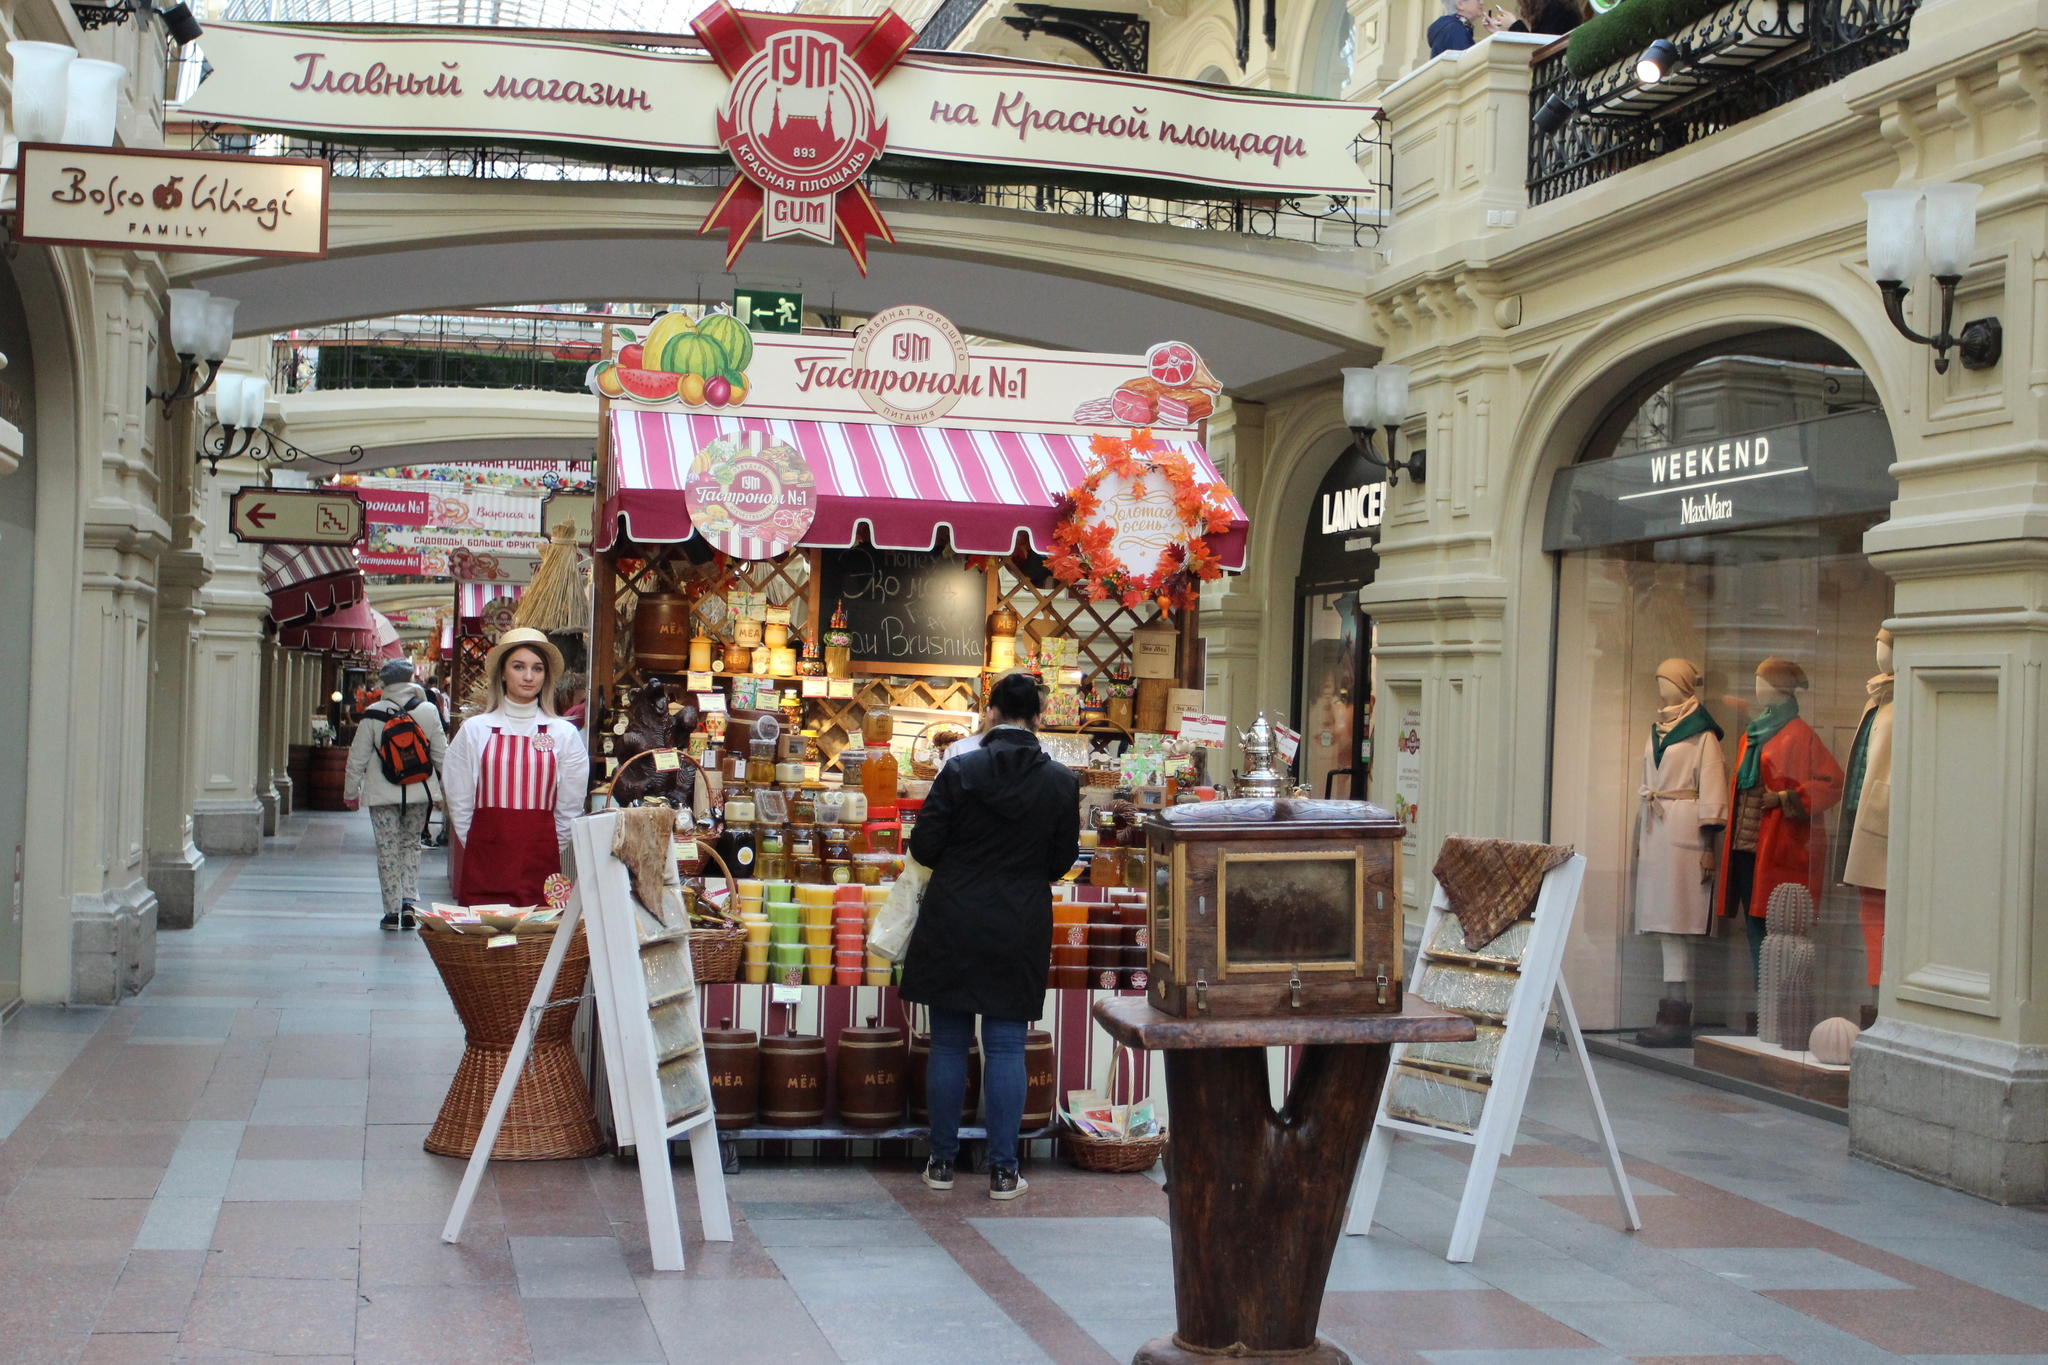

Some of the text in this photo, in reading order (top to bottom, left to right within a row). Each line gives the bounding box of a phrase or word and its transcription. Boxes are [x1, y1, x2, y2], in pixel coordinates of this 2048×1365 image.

[772, 35, 838, 88] ГУМ
[290, 53, 652, 111] Главный магазин
[929, 91, 1307, 168] на Красной площади
[738, 144, 866, 192] КРАСНАЯ ПЛОЩАДЬ
[52, 167, 295, 230] Bosco Ciliegi
[774, 199, 826, 224] GUM
[128, 222, 207, 237] FAMILY
[857, 308, 966, 361] КОМБИНАТ ХОРОШЕГО
[892, 332, 931, 364] ГУМ
[794, 357, 1027, 399] Гастроном №1
[883, 406, 936, 421] ПИТАНИЯ
[1651, 437, 1769, 484] WEEKEND
[695, 486, 807, 506] Гастроном №1
[741, 476, 760, 490] ГУМ
[366, 500, 425, 514] роном №1
[476, 507, 524, 520] Вкусная
[1105, 501, 1177, 530] Золотая
[1680, 493, 1733, 525] MaxMara
[1122, 520, 1165, 534] осень
[414, 536, 537, 549] САДОВОДЫ, БОЛЬШЕ ФРУКТ
[838, 548, 900, 604] Эко
[881, 616, 983, 658] Brusnika
[711, 1071, 743, 1087] МЁД
[787, 1073, 818, 1089] МЁД
[864, 1070, 895, 1085] МЁД
